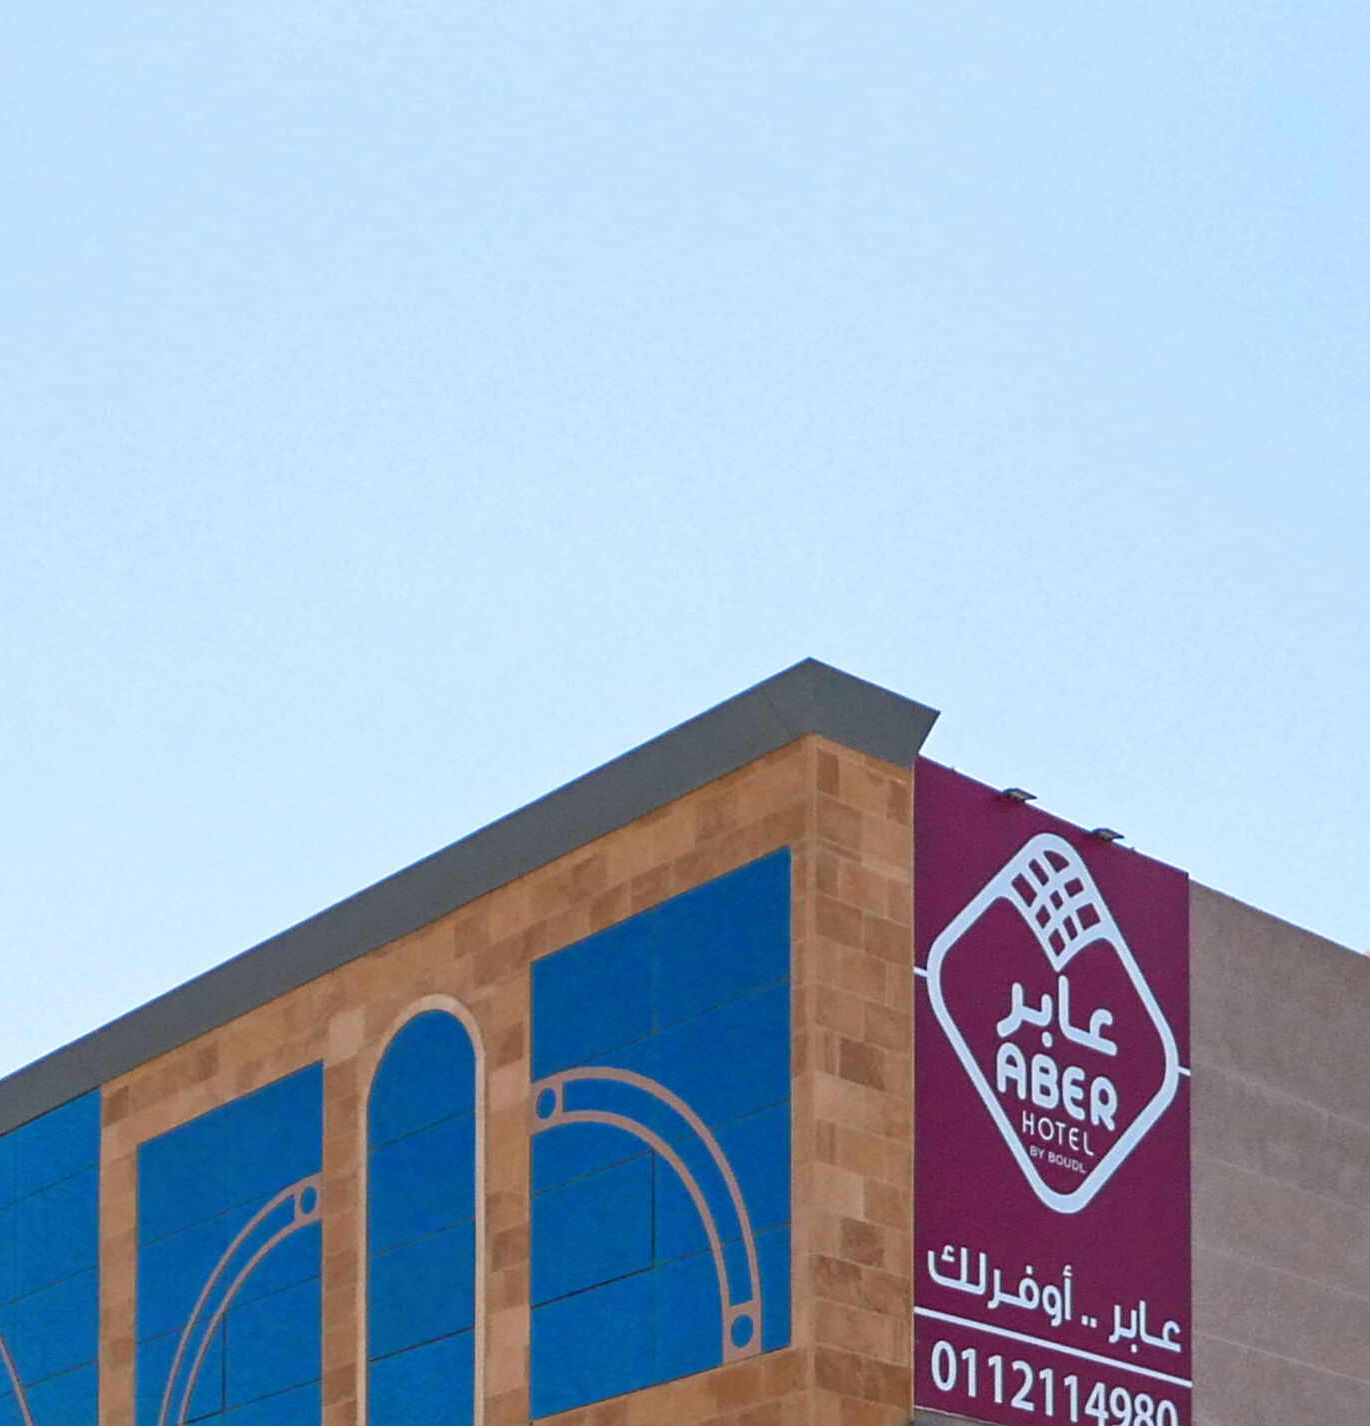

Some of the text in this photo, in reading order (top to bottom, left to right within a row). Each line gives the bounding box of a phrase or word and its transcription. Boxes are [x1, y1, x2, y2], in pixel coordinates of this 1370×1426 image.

[997, 975, 1118, 1056] عابر
[997, 1042, 1118, 1132] ABER
[1022, 1110, 1094, 1157] HOTEL
[1029, 1145, 1086, 1174] BY BOUDL
[1108, 1300, 1182, 1353] عابر
